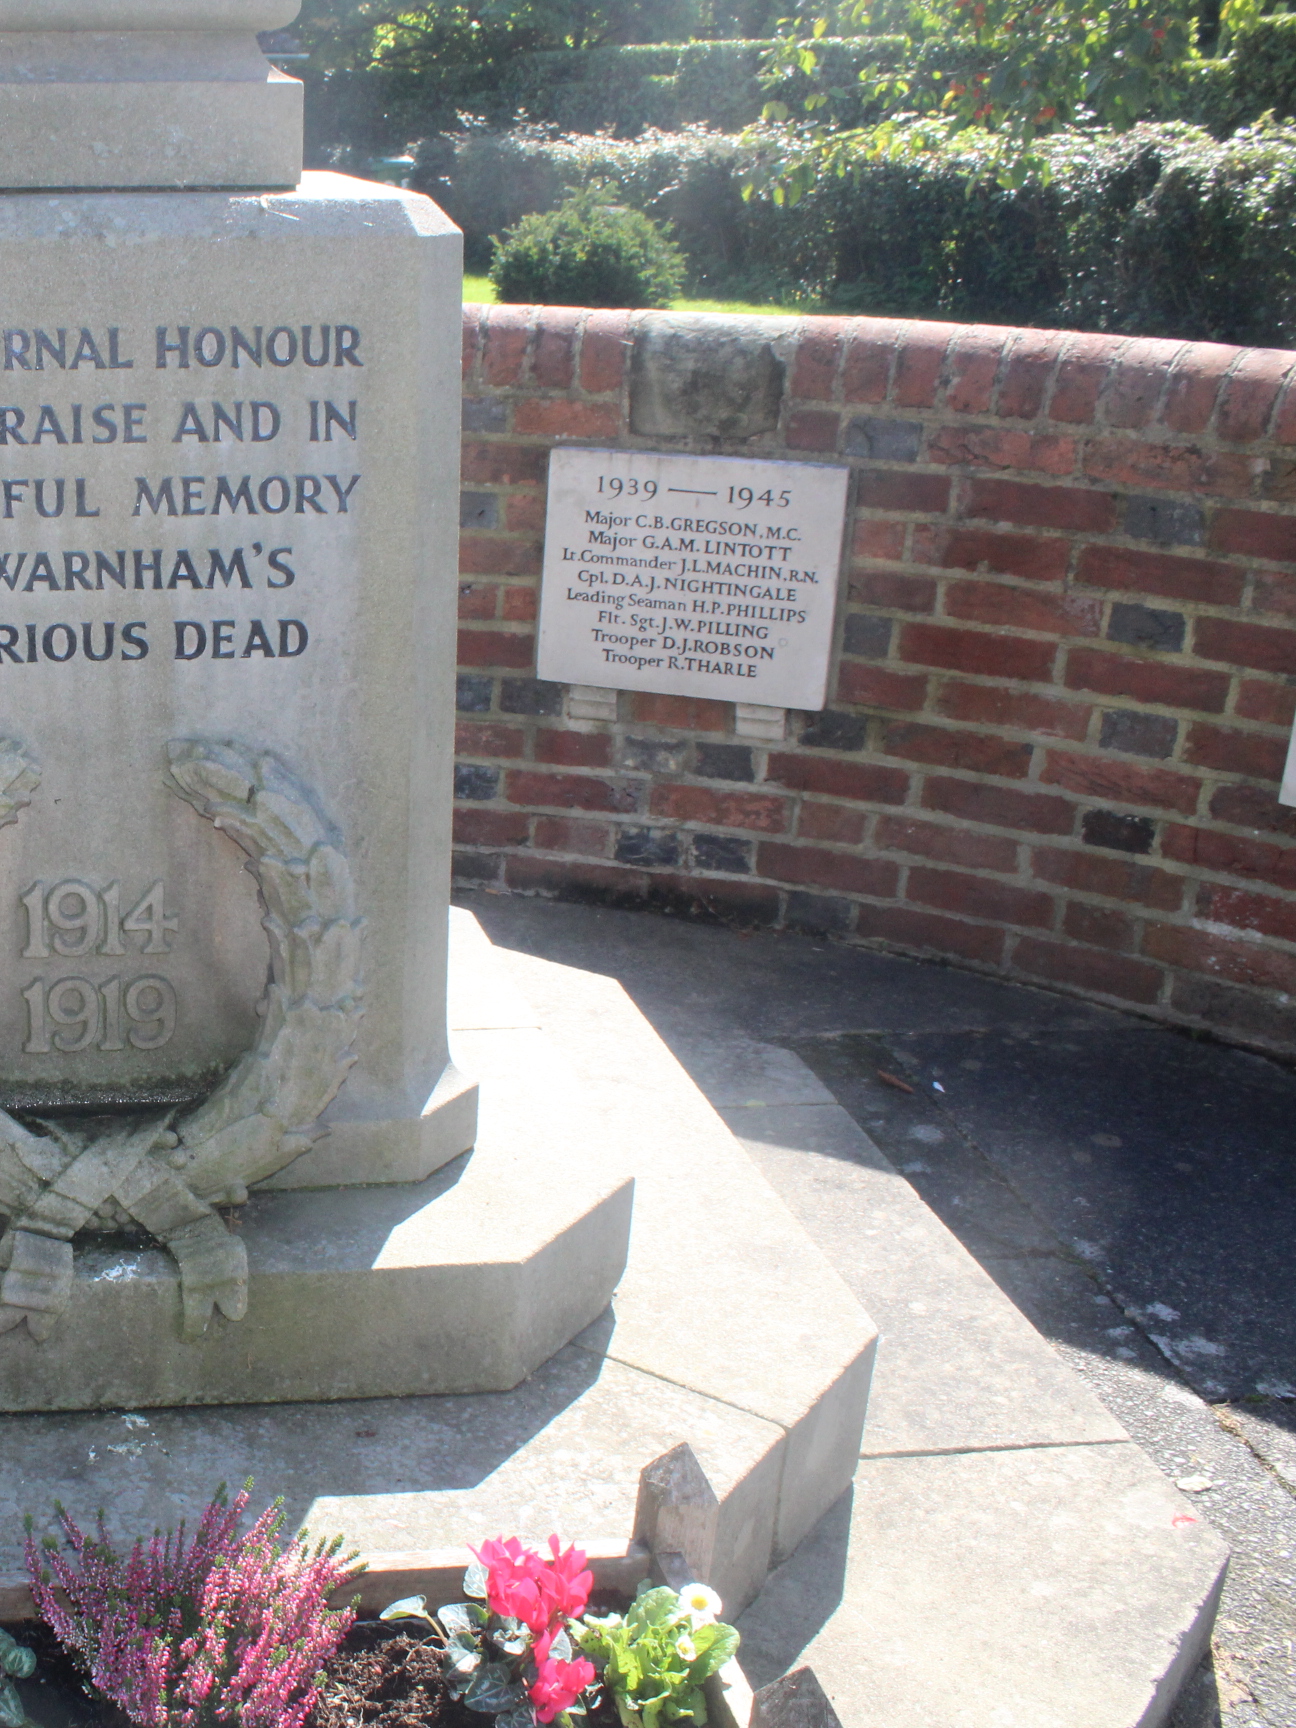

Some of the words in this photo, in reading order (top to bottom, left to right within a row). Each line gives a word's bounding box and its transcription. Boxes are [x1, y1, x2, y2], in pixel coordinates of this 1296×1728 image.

[155, 325, 364, 369] HONOUR
[173, 400, 282, 444] AND
[309, 399, 358, 442] IN
[132, 474, 361, 517] MEMORY
[597, 475, 658, 502] 1939
[728, 485, 792, 510] 1945
[584, 509, 632, 531] Major
[588, 530, 638, 553] Major
[566, 587, 627, 611] Leading
[174, 619, 309, 661] DEAD
[591, 628, 657, 651] Trooper
[602, 648, 665, 671] Trooper
[20, 878, 179, 959] 1914
[21, 974, 177, 1054] 1919
